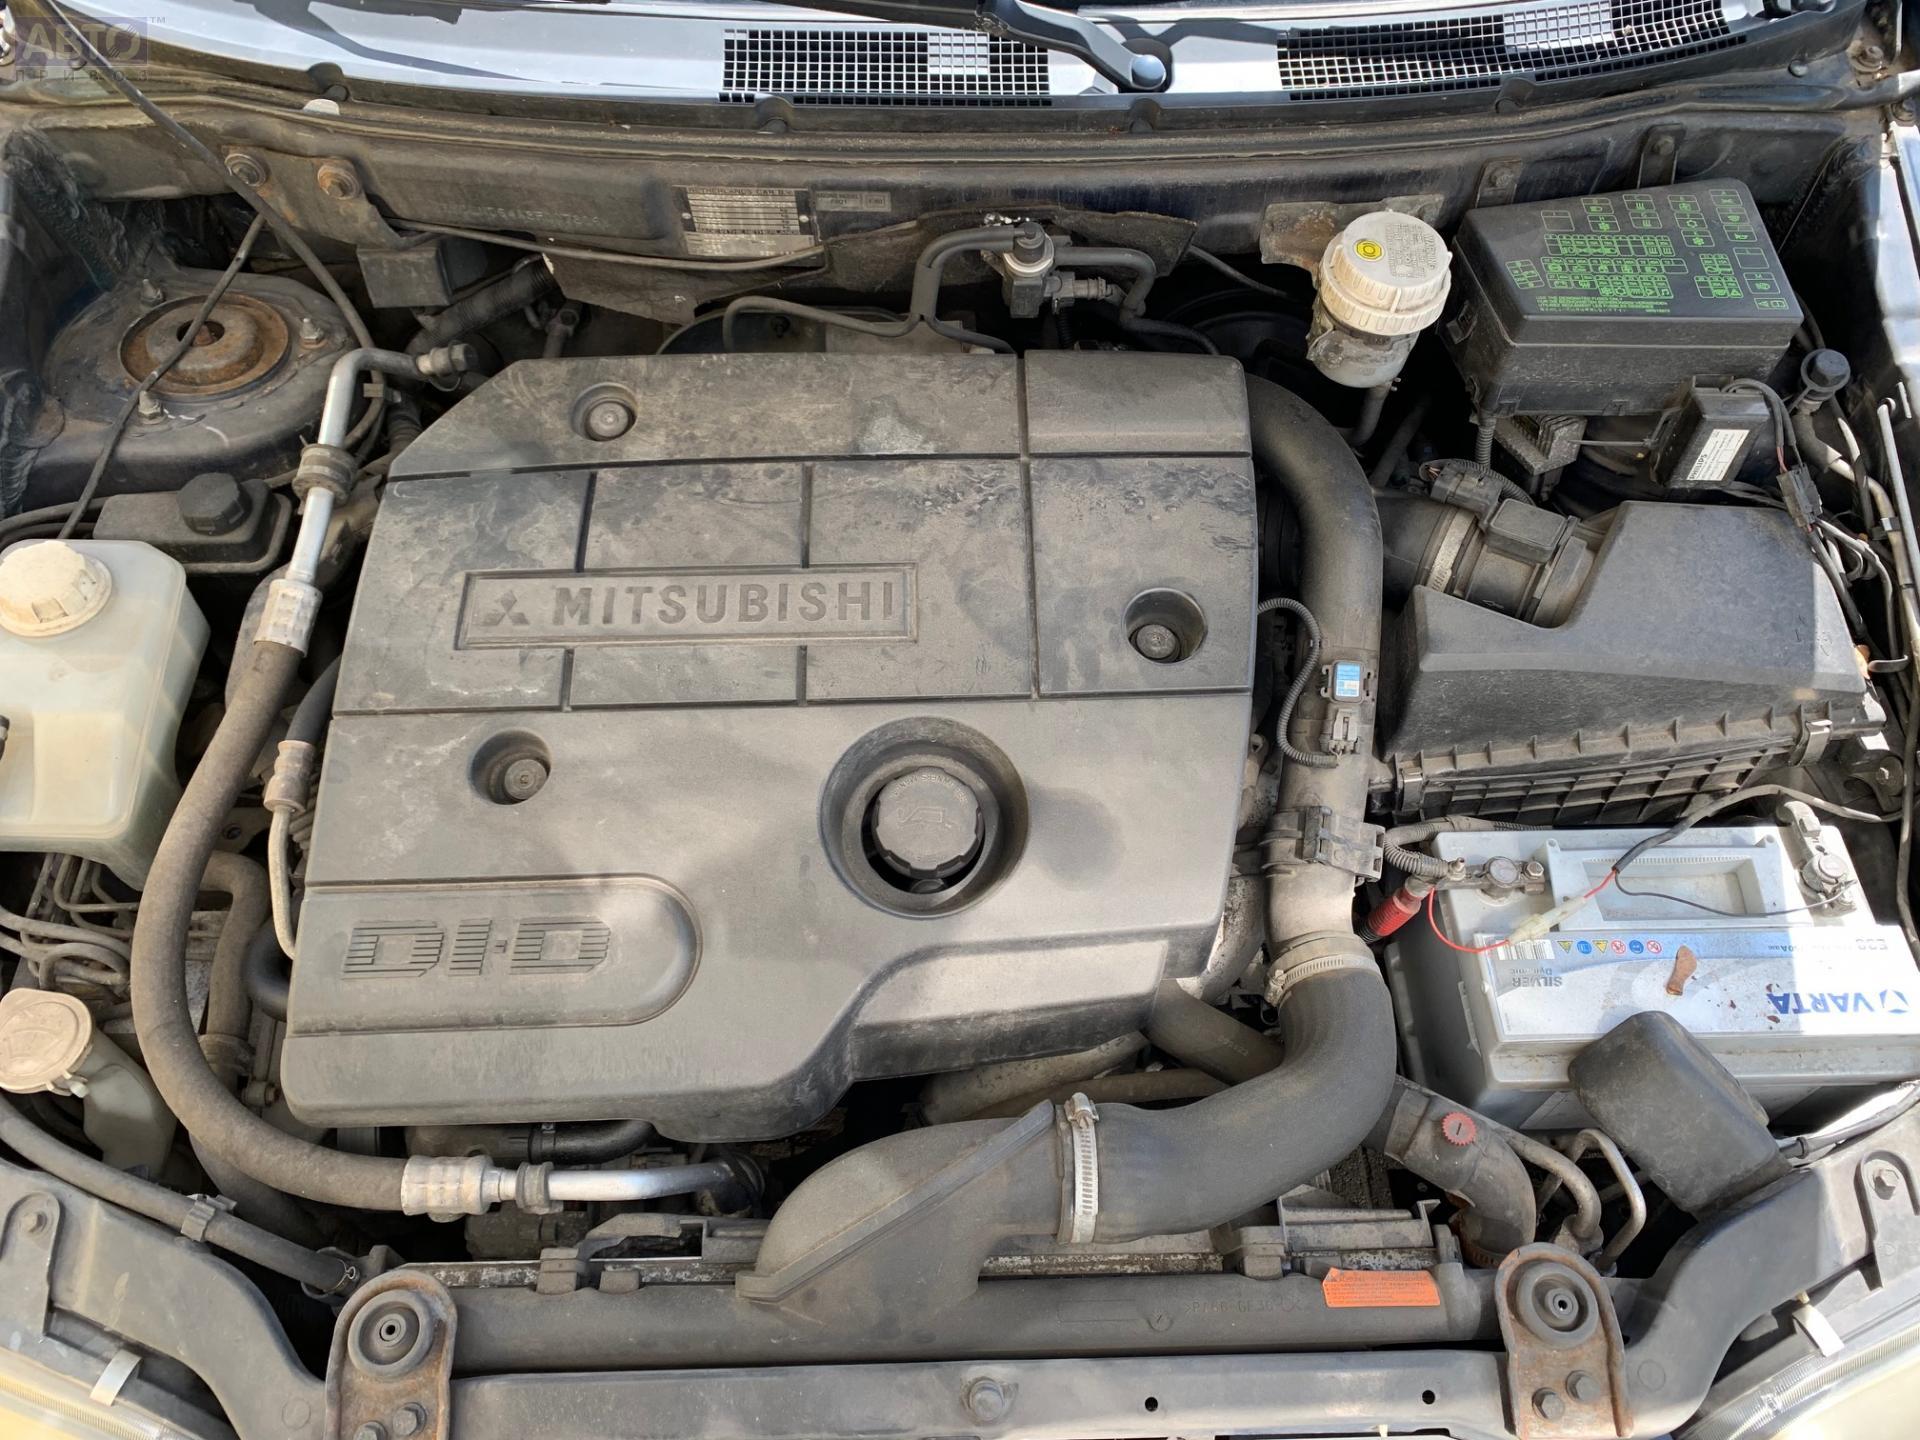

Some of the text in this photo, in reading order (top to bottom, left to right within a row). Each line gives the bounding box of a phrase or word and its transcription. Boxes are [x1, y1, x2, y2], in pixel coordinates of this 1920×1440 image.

[1689, 453, 1708, 479] PHILIPS
[552, 581, 894, 626] MITSUBISHI
[1512, 976, 1562, 987] SILVER
[1766, 992, 1876, 1014] VARTA
